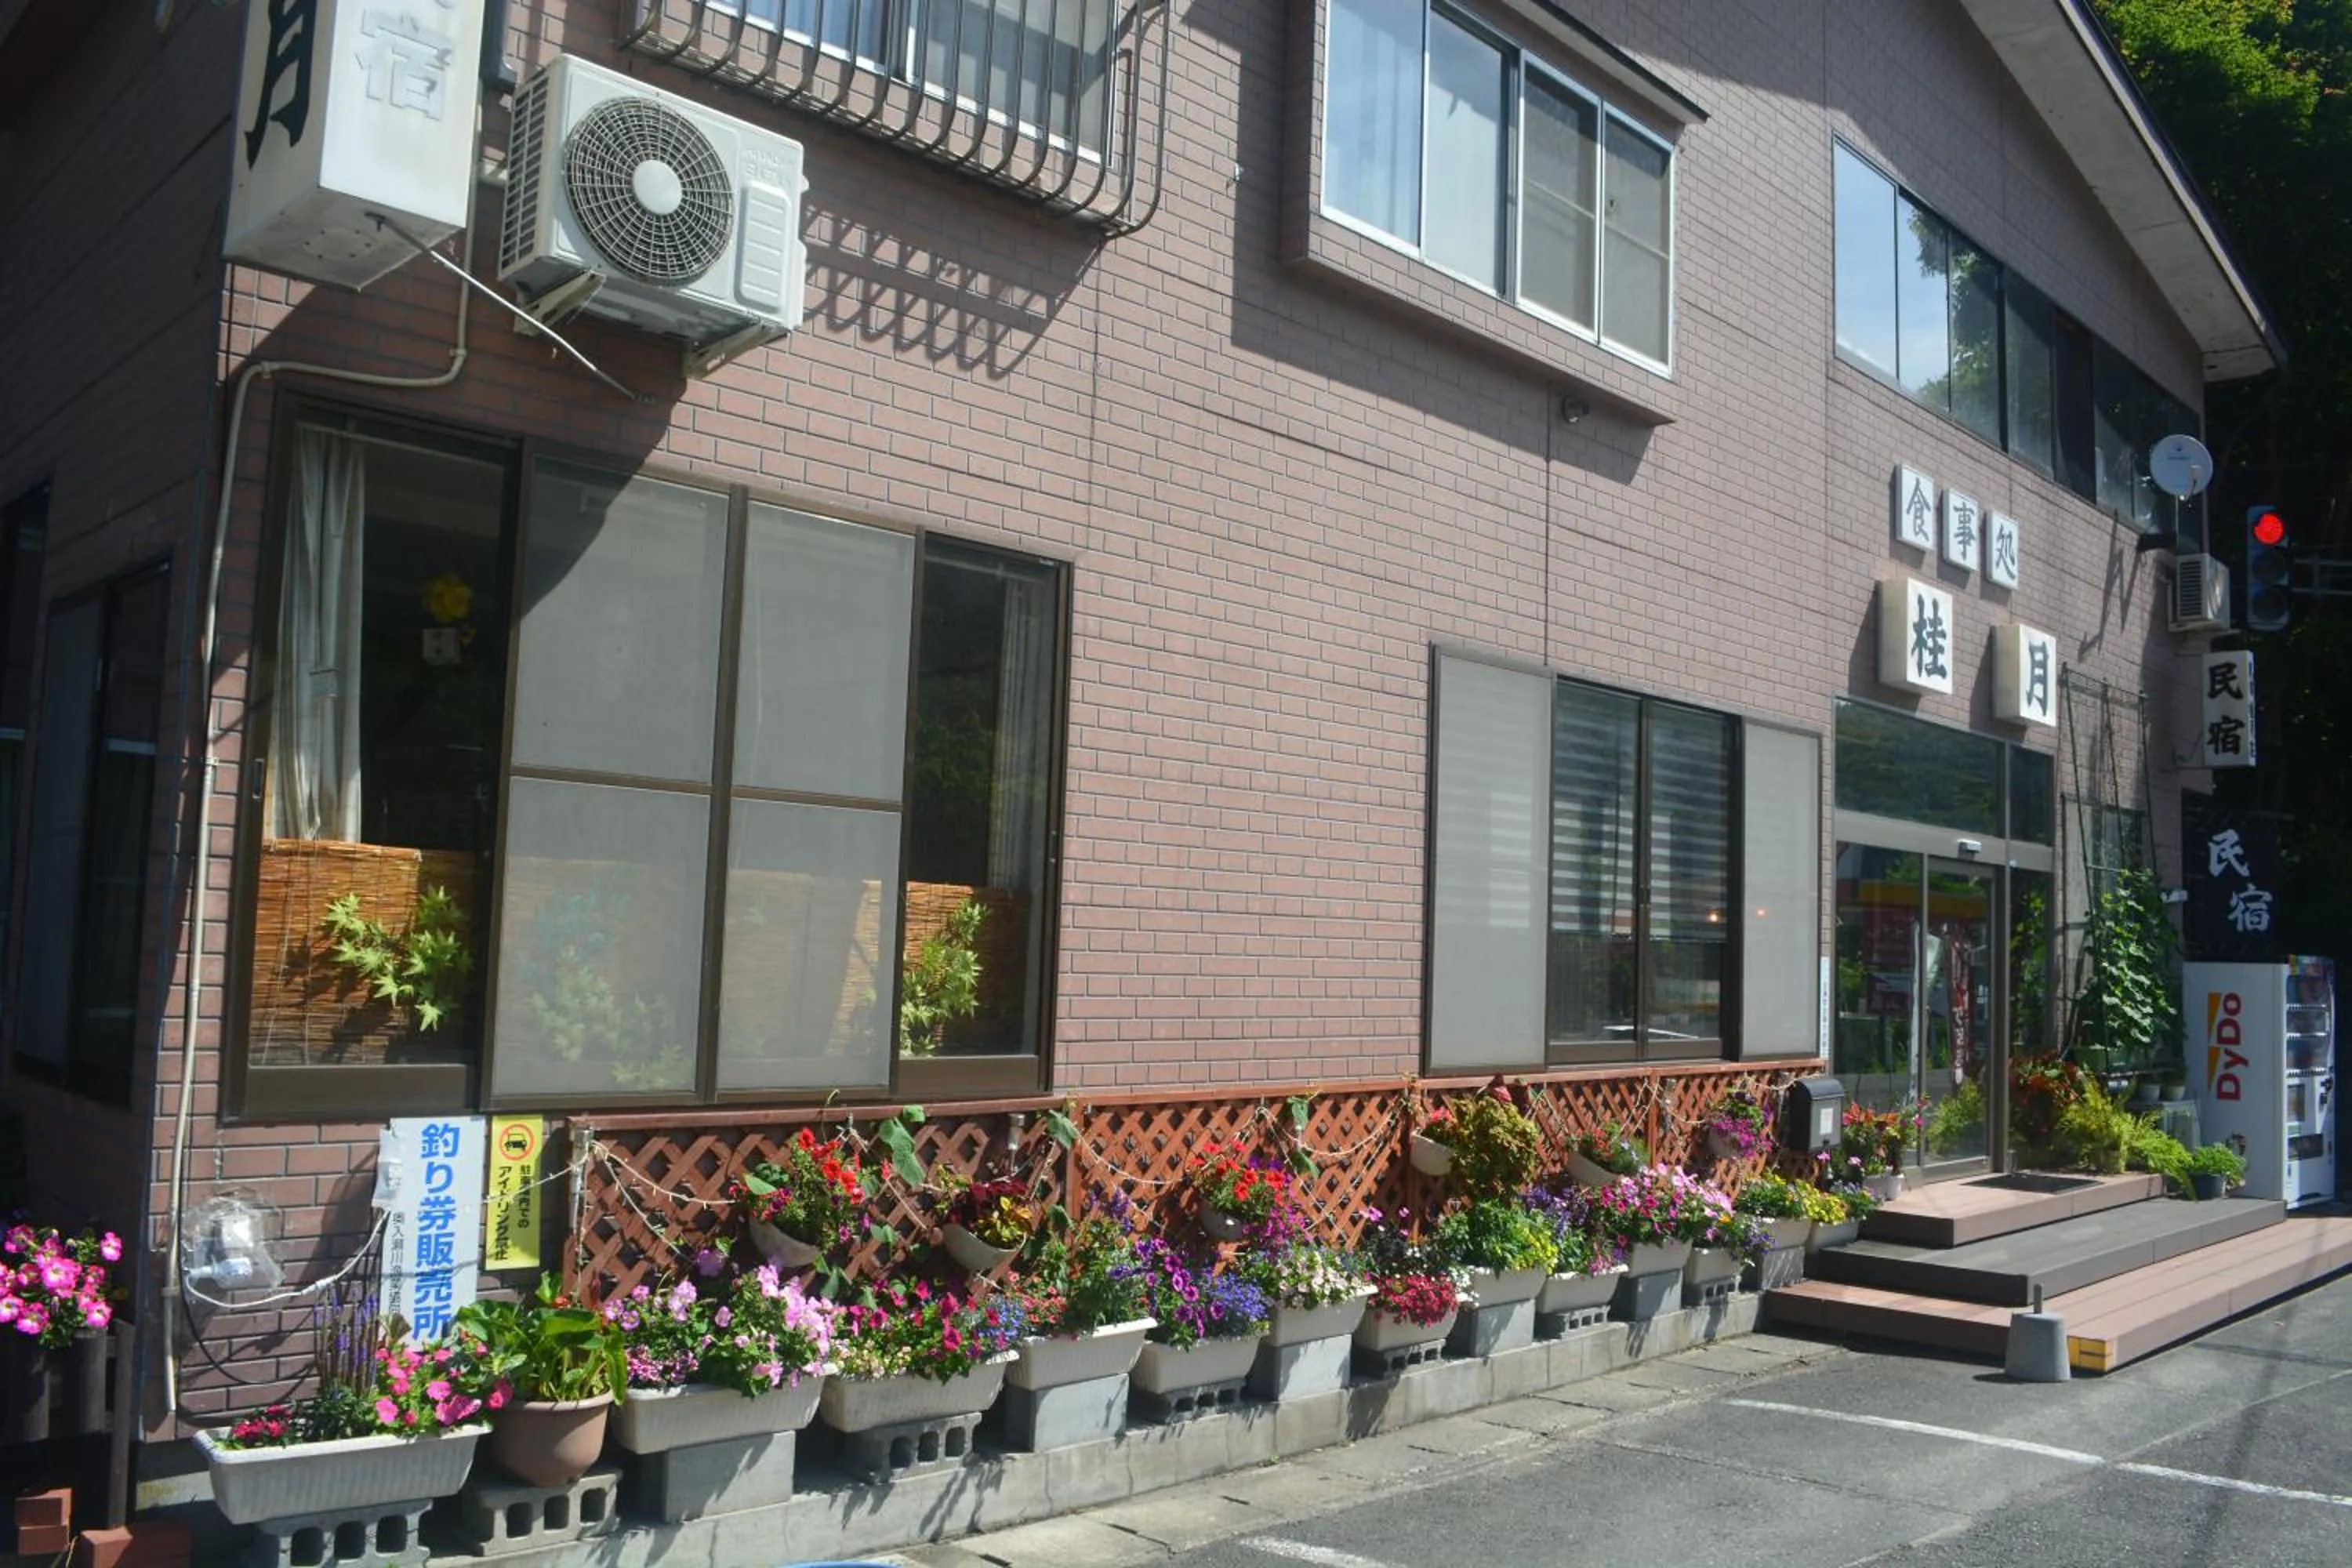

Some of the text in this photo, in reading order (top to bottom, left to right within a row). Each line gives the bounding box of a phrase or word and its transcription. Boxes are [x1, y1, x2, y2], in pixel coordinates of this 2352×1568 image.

[1906, 477, 2016, 581] 食事処
[1911, 593, 2053, 717] 桂月
[2206, 661, 2245, 756] 民宿
[2208, 828, 2273, 932] 民宿
[2216, 992, 2249, 1101] DyDo
[412, 1123, 460, 1341] 釣り券販売所
